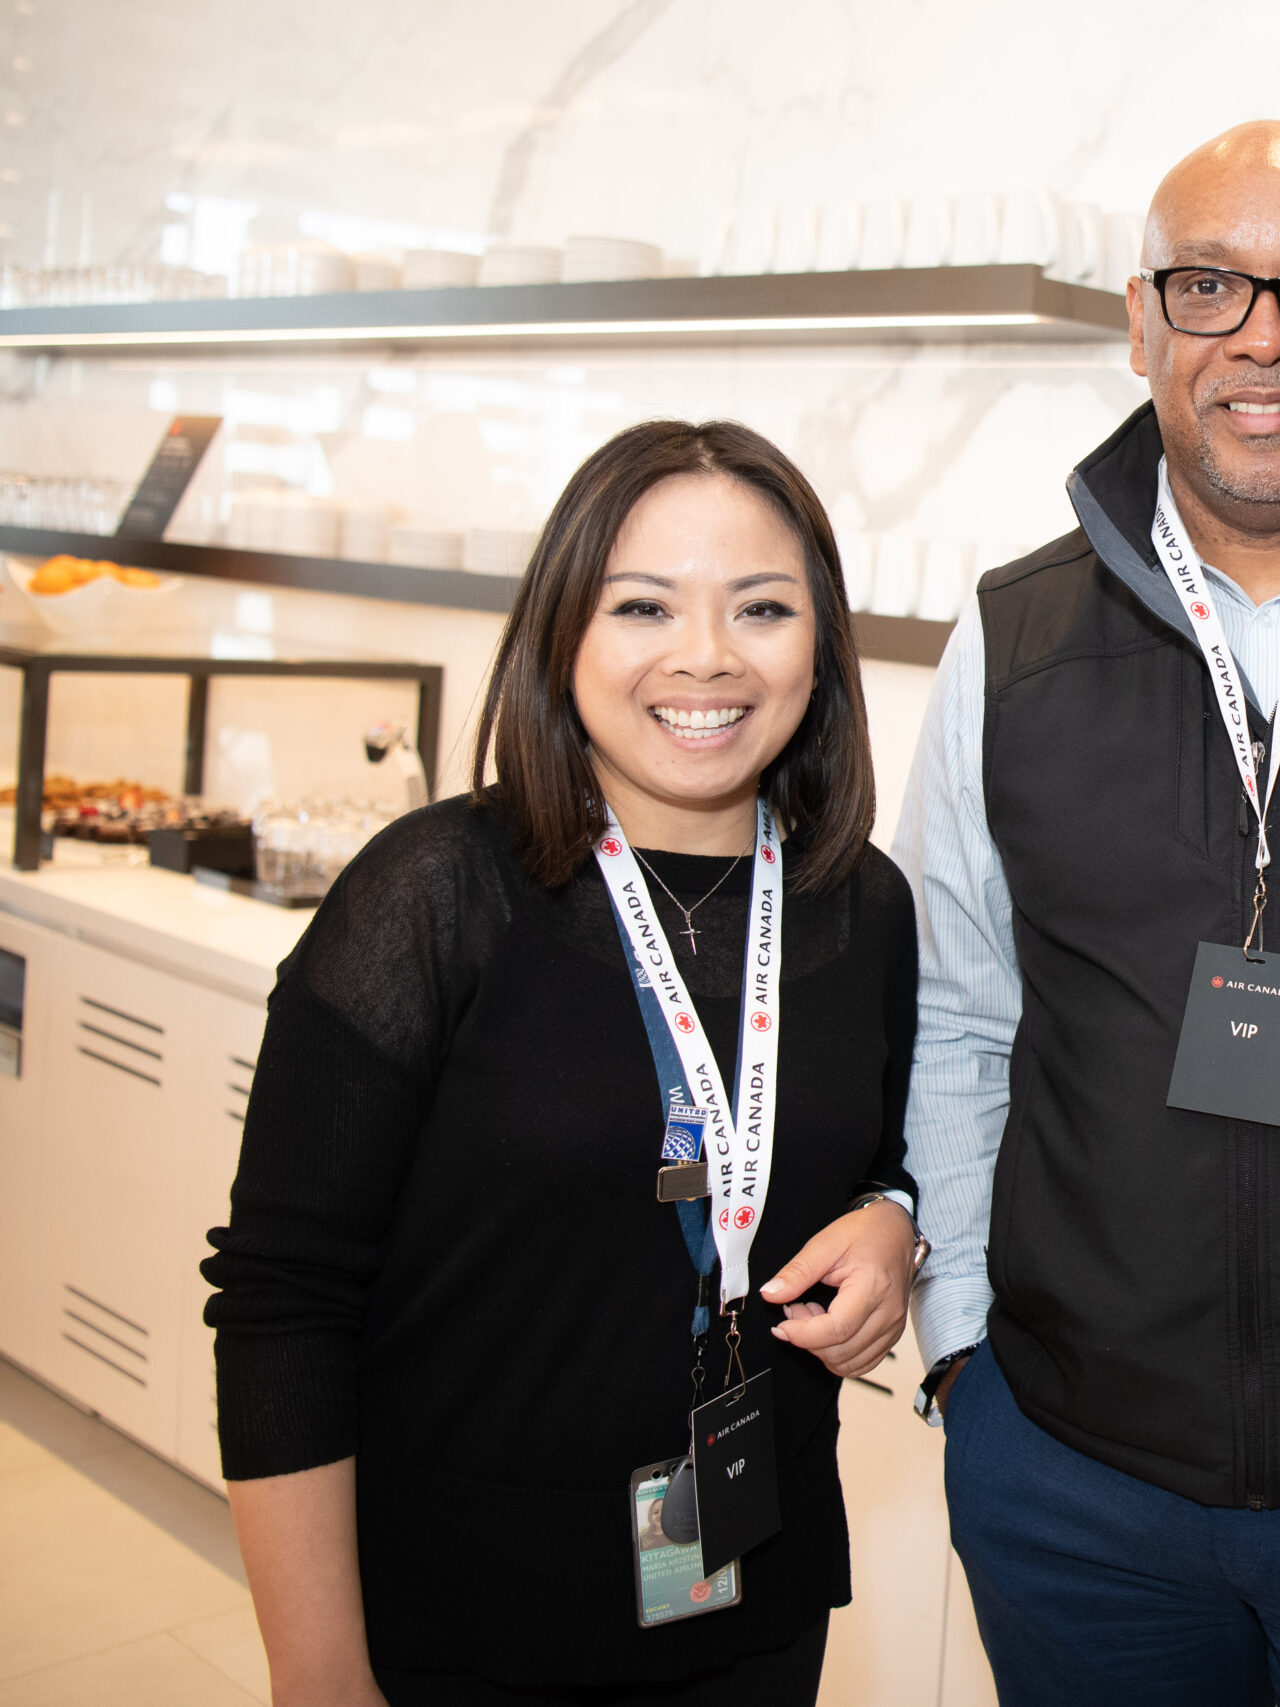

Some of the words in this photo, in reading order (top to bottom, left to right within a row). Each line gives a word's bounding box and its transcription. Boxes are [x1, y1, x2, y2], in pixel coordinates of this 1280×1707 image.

[1177, 564, 1198, 594] AIR
[1211, 645, 1240, 725] CANADA
[1236, 733, 1249, 767] AIR
[622, 880, 663, 966] CANADA
[758, 889, 773, 966] CANADA
[658, 971, 682, 1004] AIR
[755, 973, 768, 1004] AIR
[1226, 980, 1245, 990] AIR
[1230, 1021, 1258, 1038] VIP
[671, 1106, 707, 1116] UNITED
[696, 1063, 729, 1155] CANADA
[746, 1062, 764, 1152] CANADA
[721, 1161, 732, 1197] AIR
[742, 1160, 758, 1197] AIR
[717, 1427, 729, 1439] AIR
[730, 1409, 760, 1431] CANADA
[726, 1458, 745, 1479] VIP
[643, 1569, 672, 1581] UNITED
[674, 1561, 702, 1575] AIRLIN
